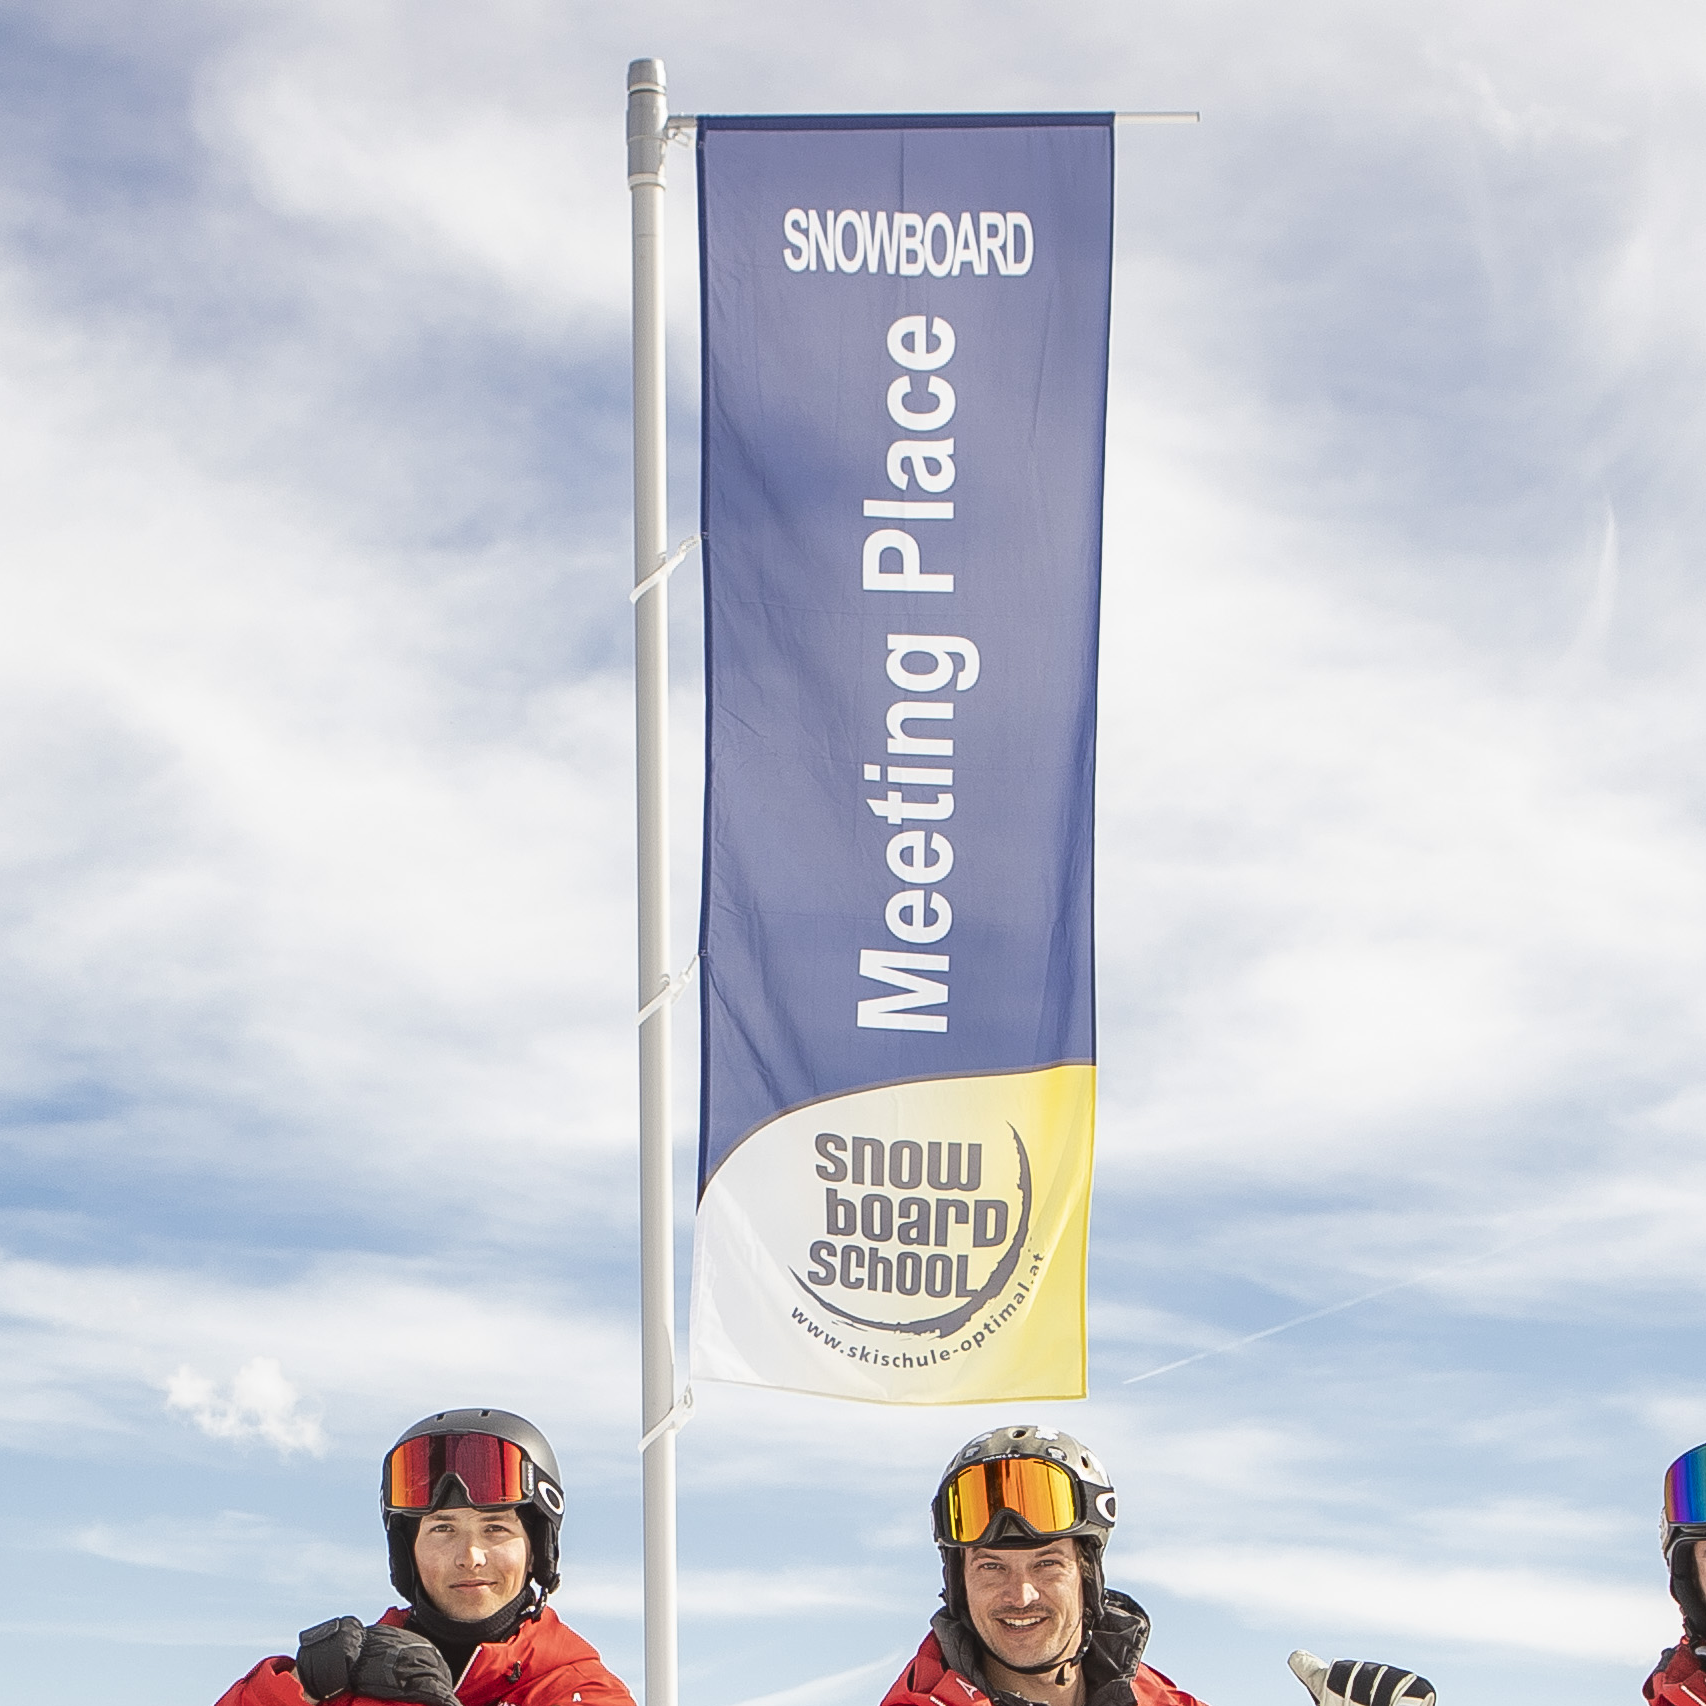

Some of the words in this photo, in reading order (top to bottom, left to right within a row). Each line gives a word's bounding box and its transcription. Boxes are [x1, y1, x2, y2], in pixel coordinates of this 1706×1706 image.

[783, 208, 1035, 278] SNOWBOARD
[862, 315, 957, 593] Place
[857, 634, 981, 1033] Meeting
[790, 1252, 1045, 1369] www.skischule-optimal.at
